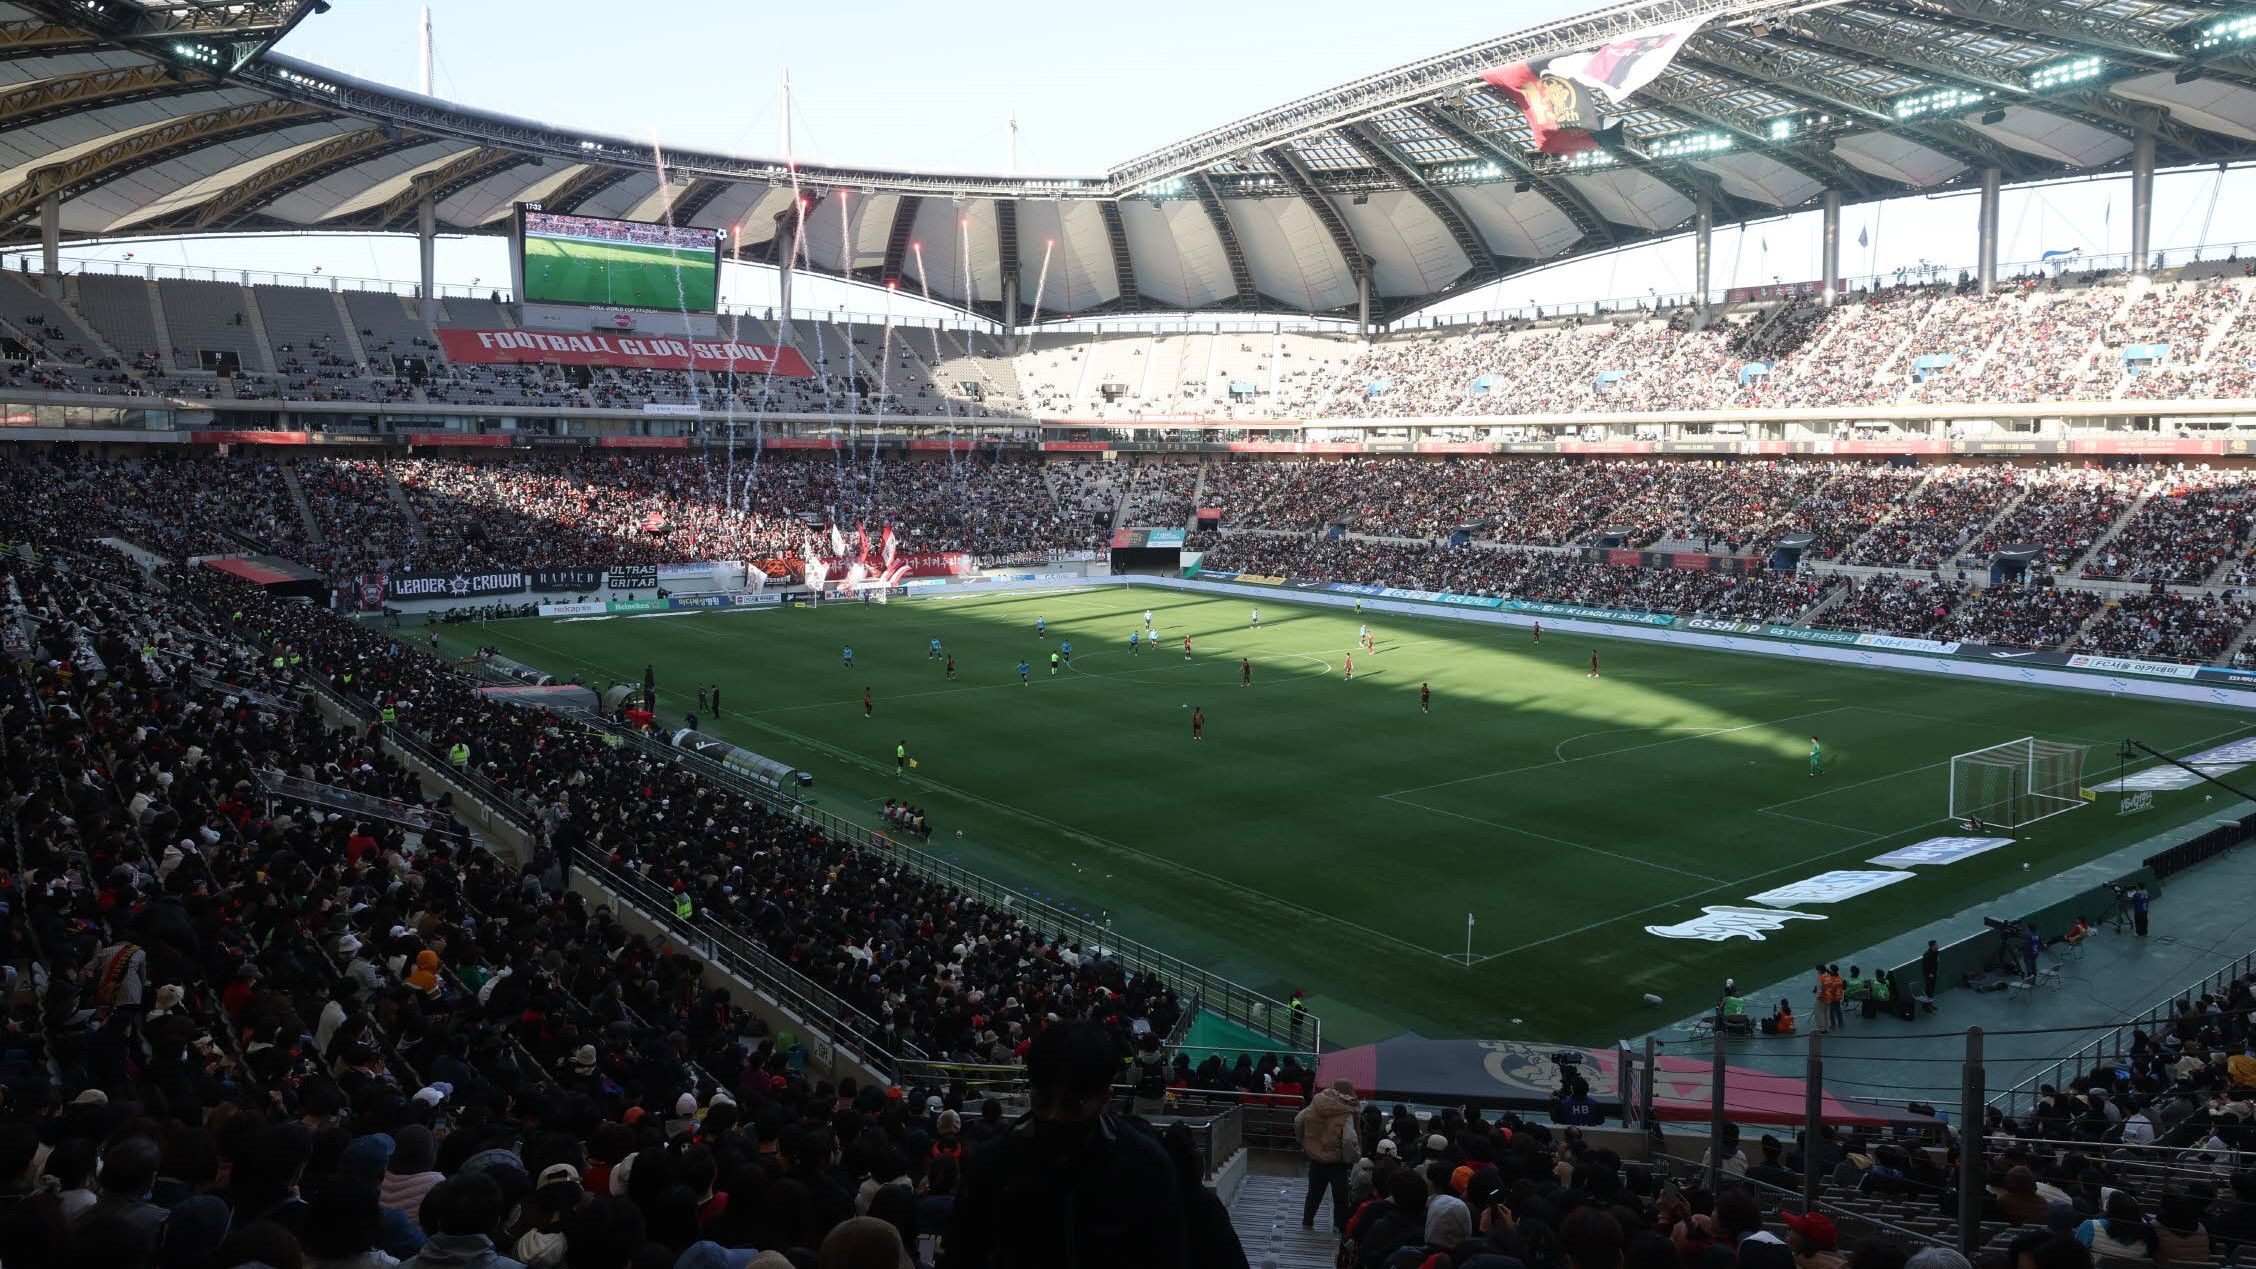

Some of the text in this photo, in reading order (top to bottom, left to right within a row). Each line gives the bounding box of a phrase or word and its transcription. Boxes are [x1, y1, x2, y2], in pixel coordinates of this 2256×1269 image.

[477, 332, 776, 362] FOOTBALL CLUB SEOUL
[610, 565, 656, 575] ULTRAS
[396, 572, 522, 595] LEADER CROWN
[610, 578, 656, 588] GRITAR
[553, 605, 581, 613] redcap
[615, 602, 651, 610] Heineken
[1576, 609, 1613, 618] LEAGUE
[1688, 618, 1762, 634] GS SHOP
[1769, 628, 1855, 643] GS THE FRESH
[2094, 659, 2178, 675] FC서울 아카데미
